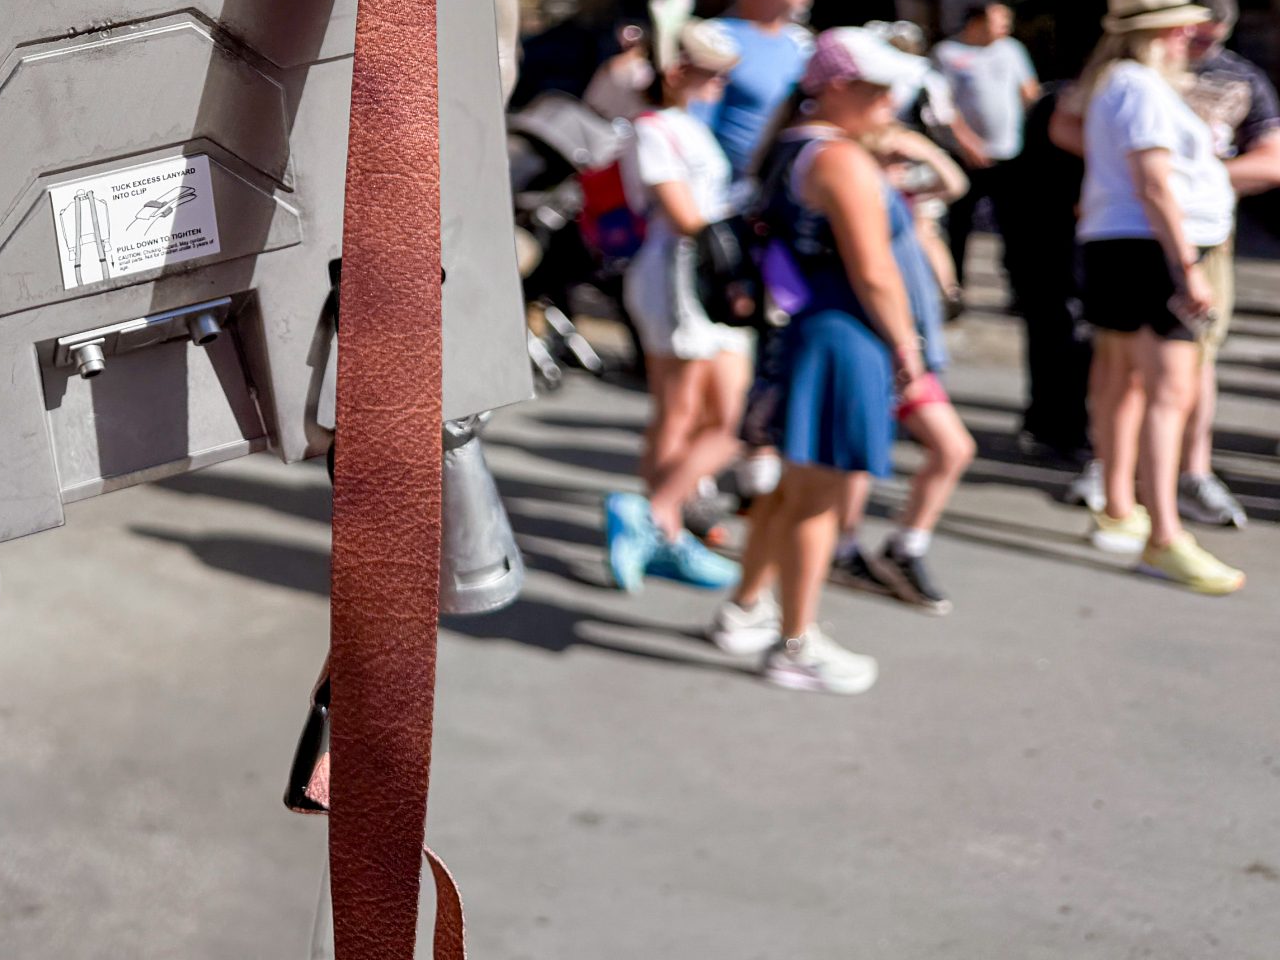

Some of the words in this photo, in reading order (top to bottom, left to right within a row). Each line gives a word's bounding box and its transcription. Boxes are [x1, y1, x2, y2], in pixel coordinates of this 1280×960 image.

[111, 183, 131, 193] TUCK
[132, 175, 161, 188] EXCESS
[162, 167, 196, 181] LANYARD
[112, 191, 130, 201] INTO
[131, 187, 147, 197] CLIP
[116, 244, 135, 254] PULL
[136, 238, 159, 249] DOWN
[160, 235, 170, 243] TO
[171, 227, 202, 240] TIGHTEN
